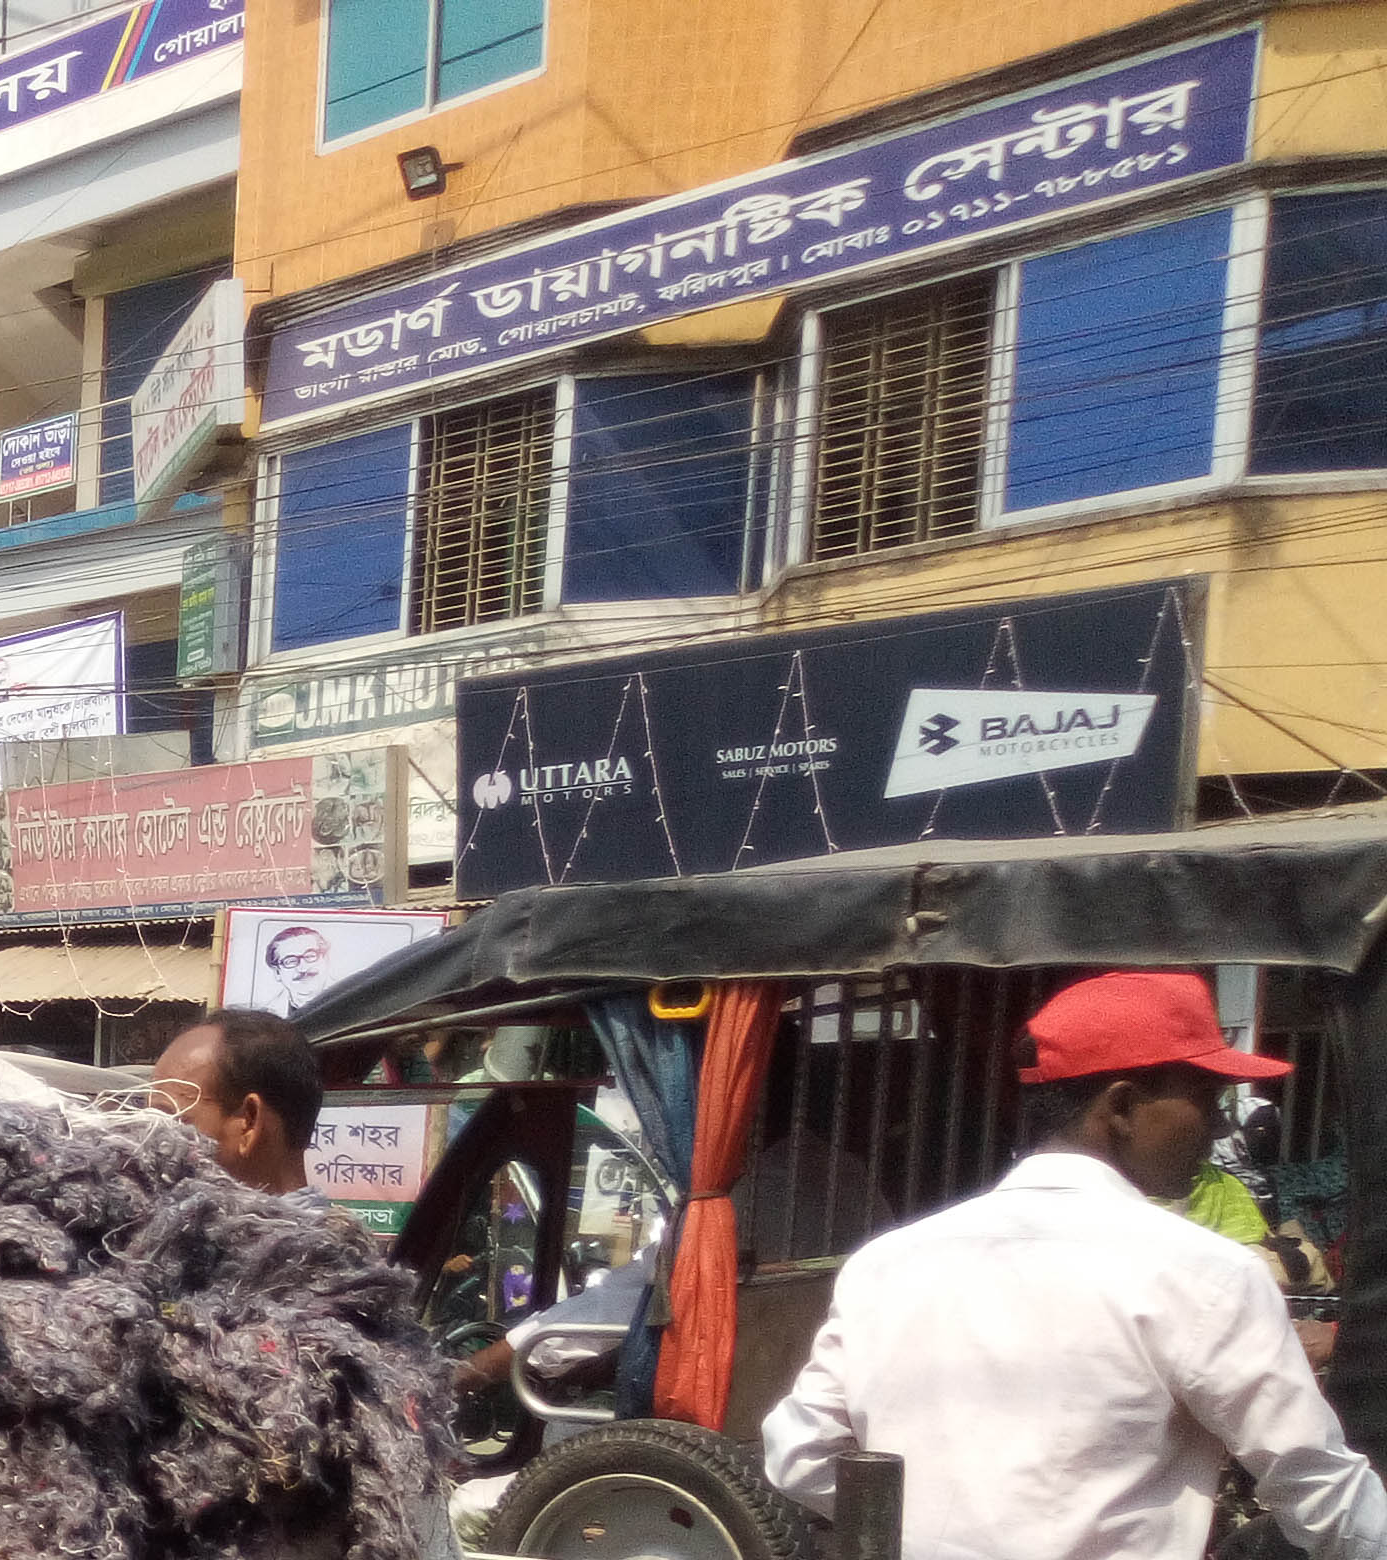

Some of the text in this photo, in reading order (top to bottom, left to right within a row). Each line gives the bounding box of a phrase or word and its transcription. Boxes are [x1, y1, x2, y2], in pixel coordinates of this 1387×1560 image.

[295, 281, 462, 369] মডার্ন
[904, 79, 1201, 202] সেন্টার
[657, 255, 769, 301] ফরিদপুর
[2, 418, 72, 457] দোকান ভাড়া
[980, 704, 1122, 742] BAJAJ
[716, 738, 838, 765] SABUZ MOTORS
[979, 733, 1120, 757] MOTORCYCLES
[520, 756, 633, 792] UTTARA
[721, 766, 747, 780] SALES
[521, 784, 633, 807] MOTORS
[135, 792, 192, 861] হোটেল
[348, 1122, 401, 1149] শহর
